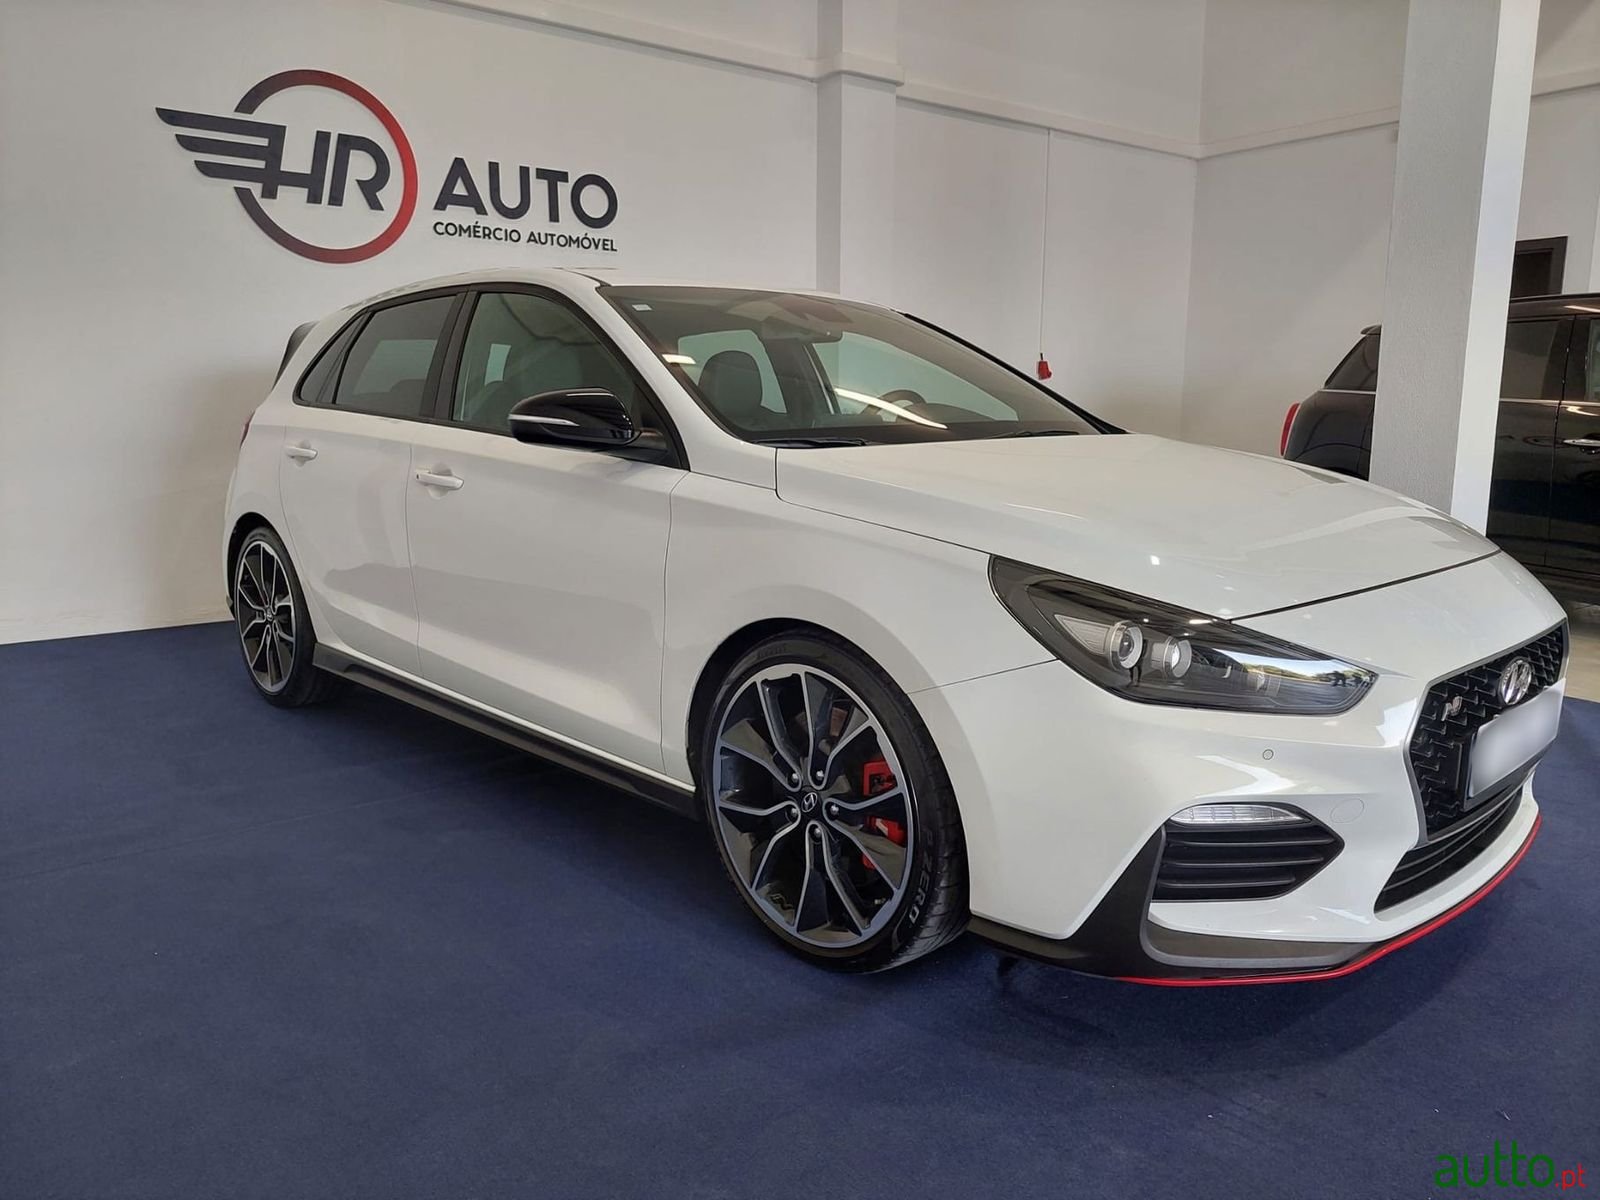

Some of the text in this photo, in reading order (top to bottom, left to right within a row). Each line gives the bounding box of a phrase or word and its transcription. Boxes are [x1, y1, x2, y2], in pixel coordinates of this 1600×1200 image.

[433, 157, 618, 229] AUTO
[433, 221, 618, 252] COMÉRCIO AUTOMÓVEL
